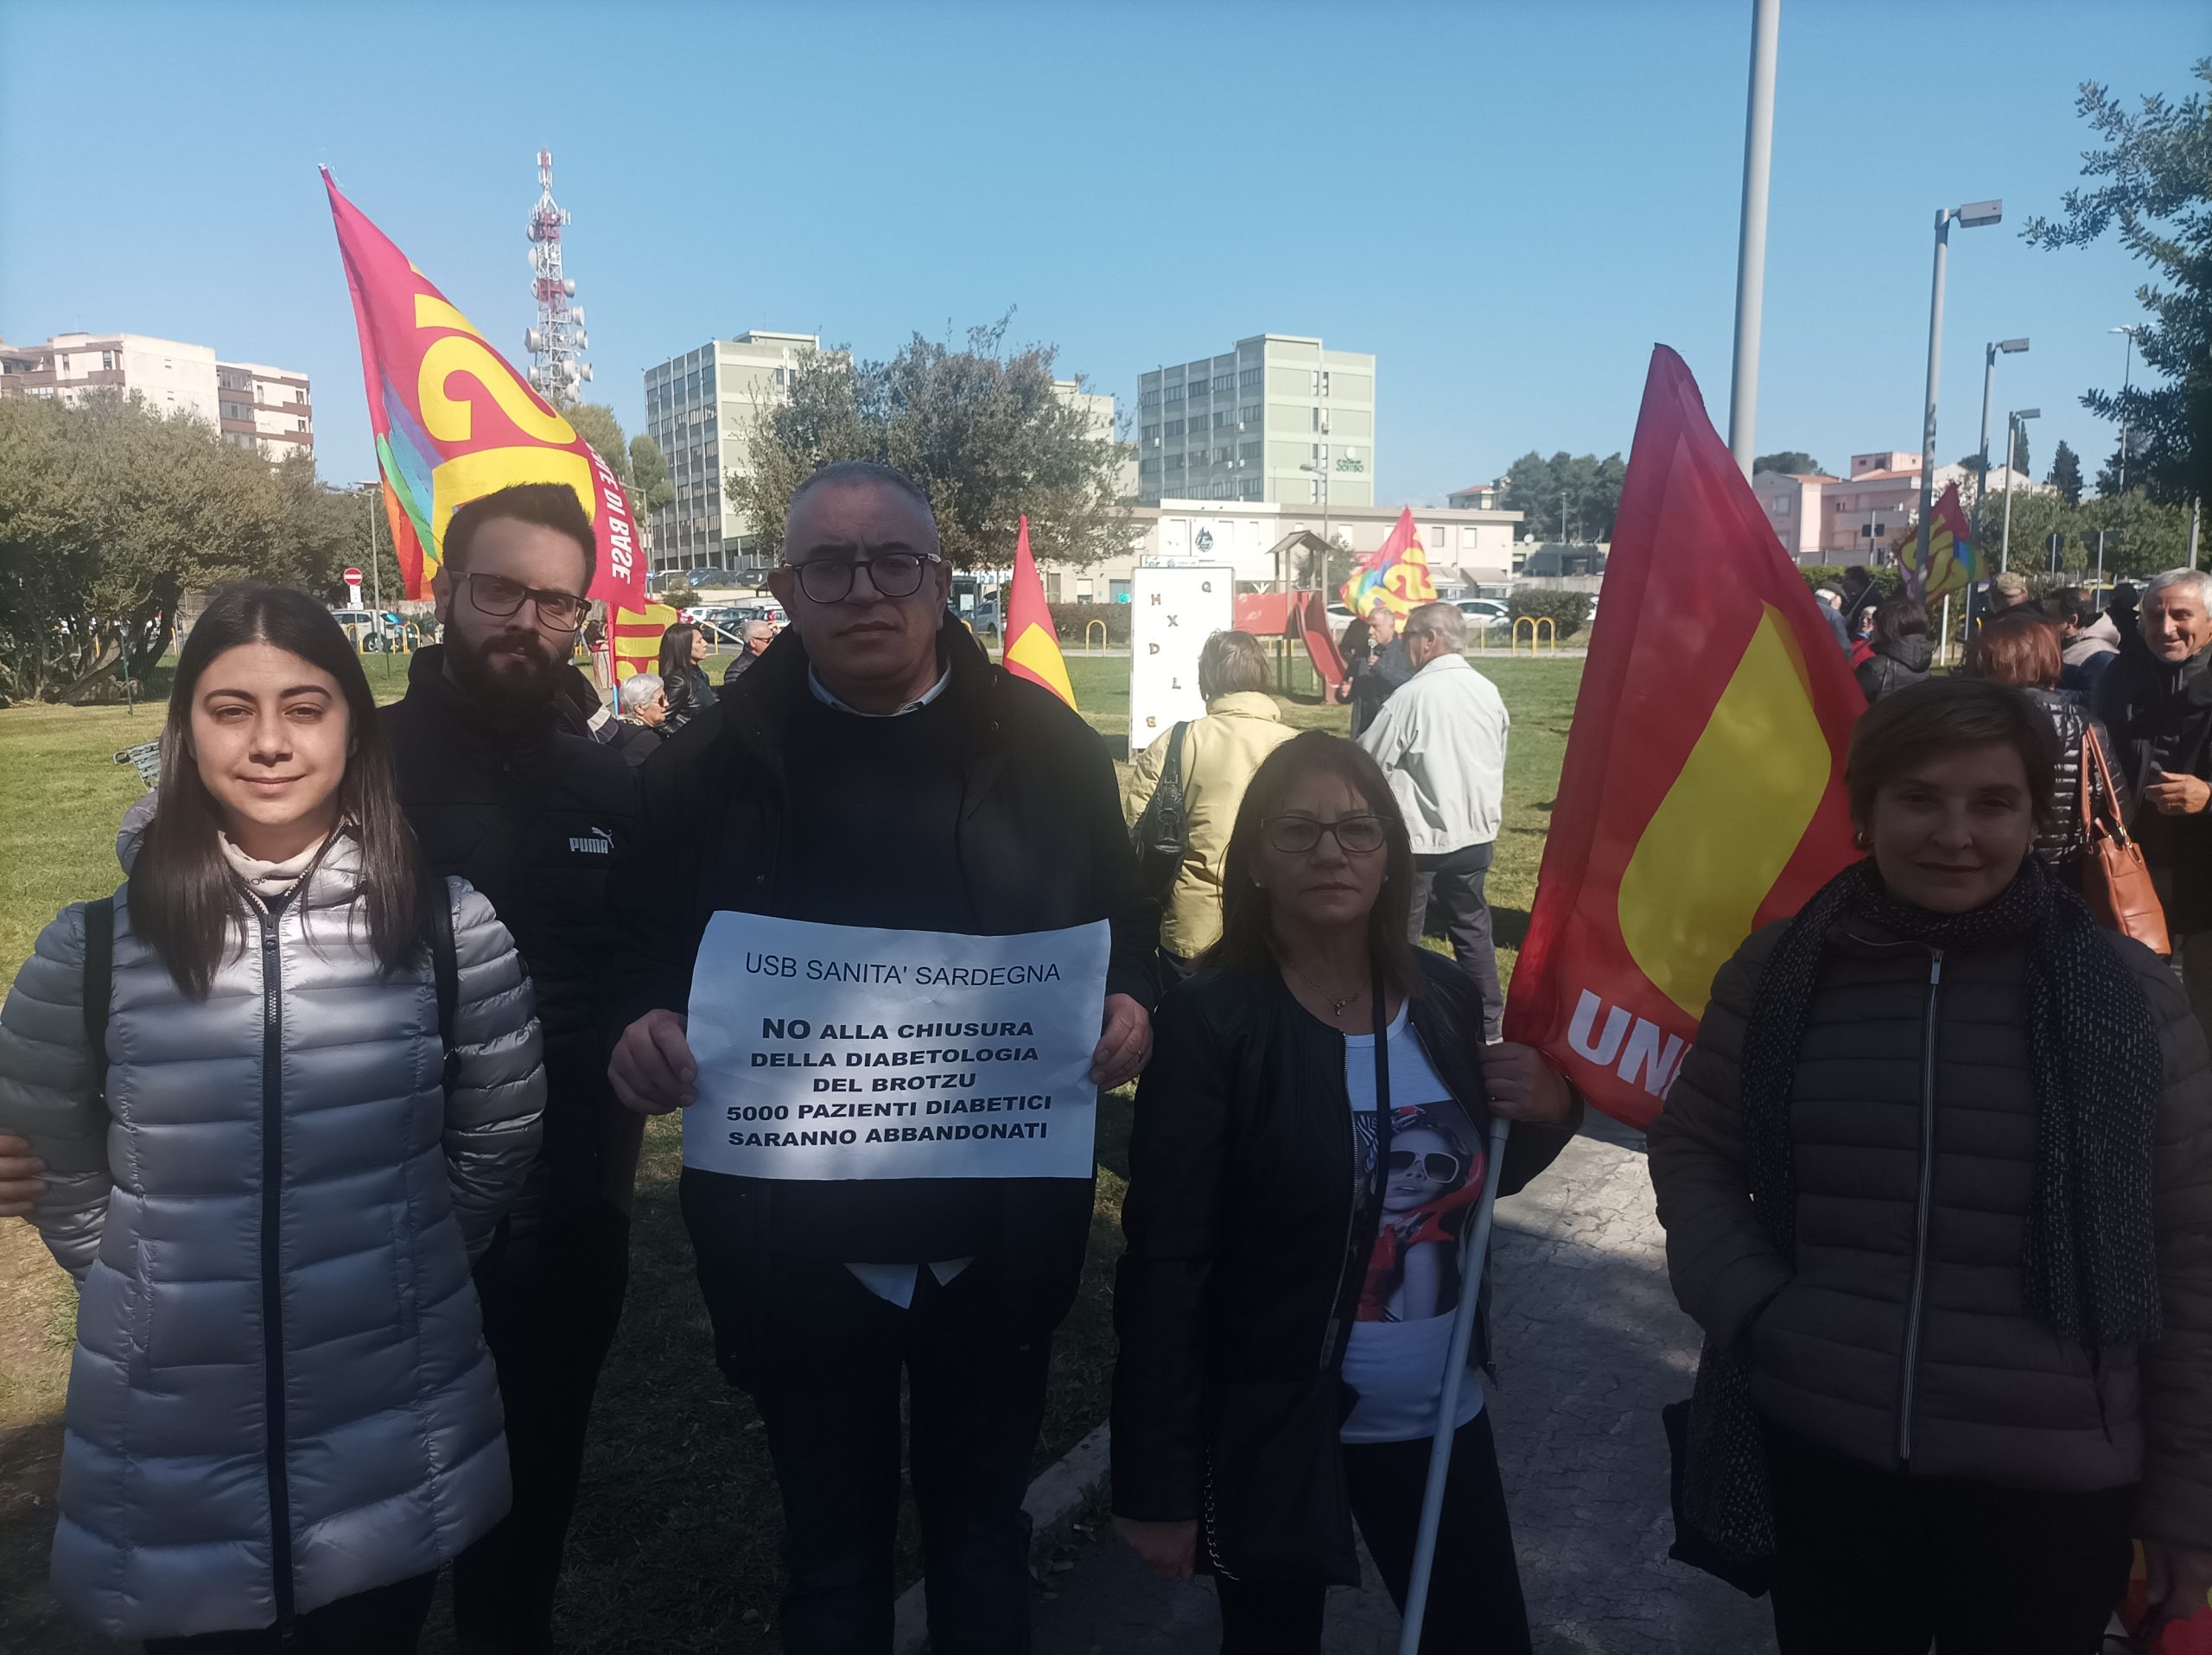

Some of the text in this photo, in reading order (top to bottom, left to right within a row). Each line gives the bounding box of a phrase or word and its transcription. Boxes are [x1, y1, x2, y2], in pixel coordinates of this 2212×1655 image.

[1202, 581, 1212, 593] Q
[1151, 594, 1161, 606] H
[1167, 614, 1179, 627] X
[1149, 643, 1160, 655] D
[1172, 678, 1181, 690] L
[569, 837, 609, 854] PUMA
[746, 952, 1061, 986] USB SANITA' SARDEGNA
[762, 1017, 1034, 1040] NO ALLA CHIUSURA
[751, 1047, 1039, 1067] DELLA DIABETOLOGIA
[813, 1073, 976, 1092] DEL BROTZU
[727, 1095, 1052, 1122] 5000 PAZIENTI DIABETICI
[728, 1122, 1047, 1147] SARANNO ABBANDONATI
